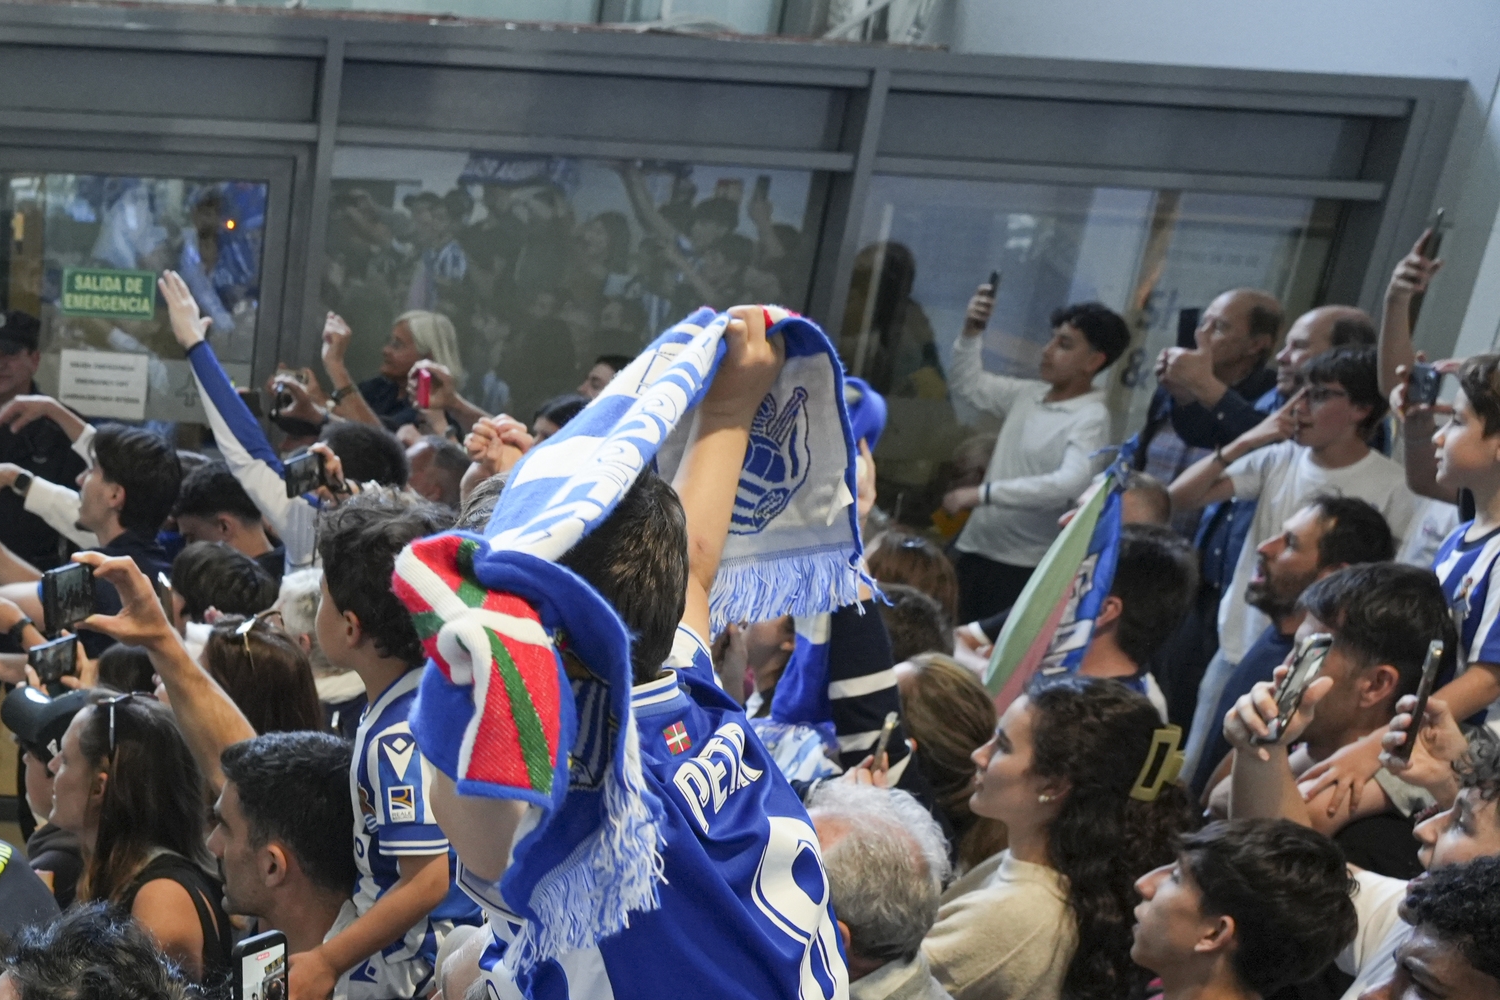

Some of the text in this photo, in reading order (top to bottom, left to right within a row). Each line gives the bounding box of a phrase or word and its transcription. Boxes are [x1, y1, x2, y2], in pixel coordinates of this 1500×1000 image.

[74, 274, 143, 294] SALIDA DE
[64, 293, 150, 313] EMERGENCIA
